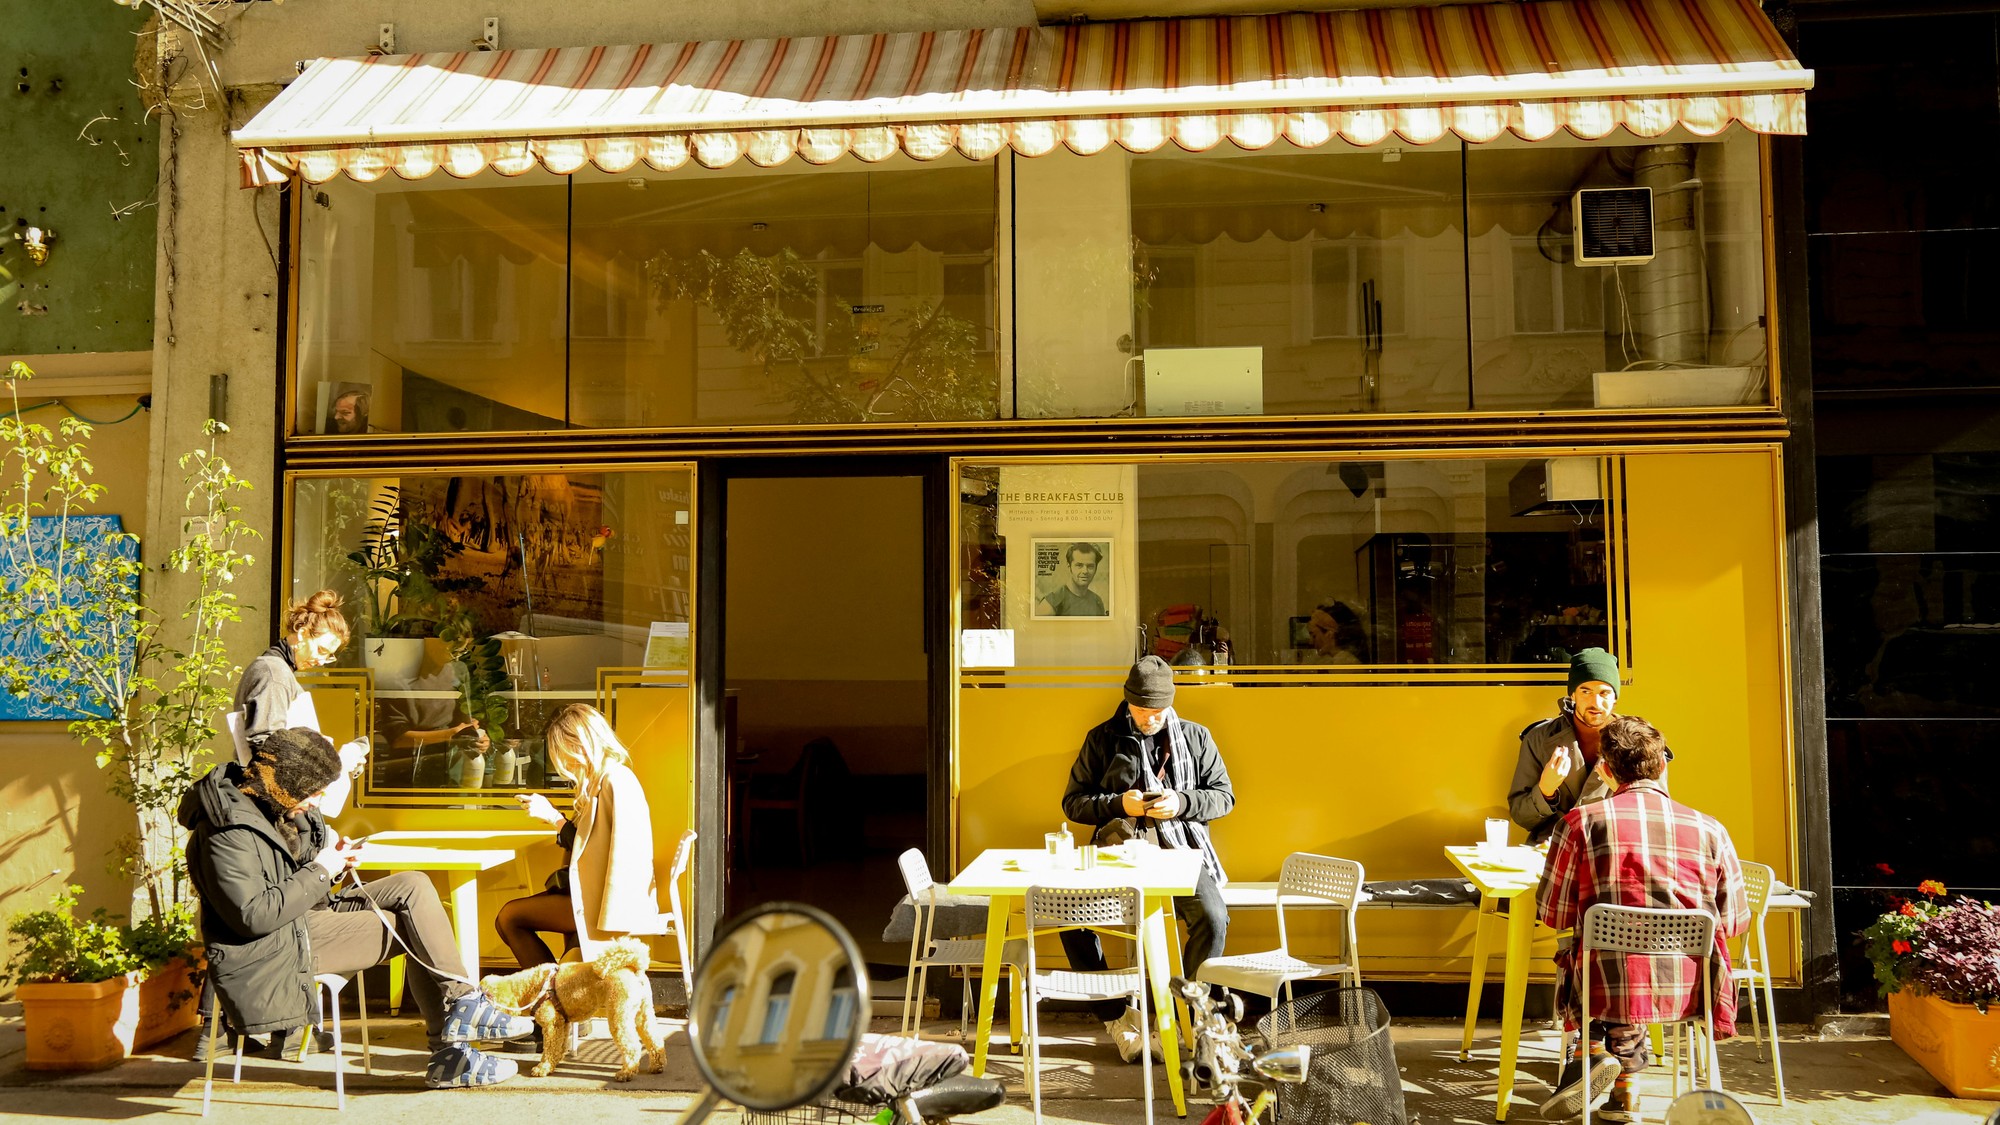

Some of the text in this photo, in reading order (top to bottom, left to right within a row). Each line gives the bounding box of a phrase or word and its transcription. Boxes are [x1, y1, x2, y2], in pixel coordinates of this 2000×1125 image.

[999, 492, 1124, 501] THE BREAKFAST CLUB
[443, 1000, 511, 1037] AIR
[426, 1048, 497, 1083] AIR
